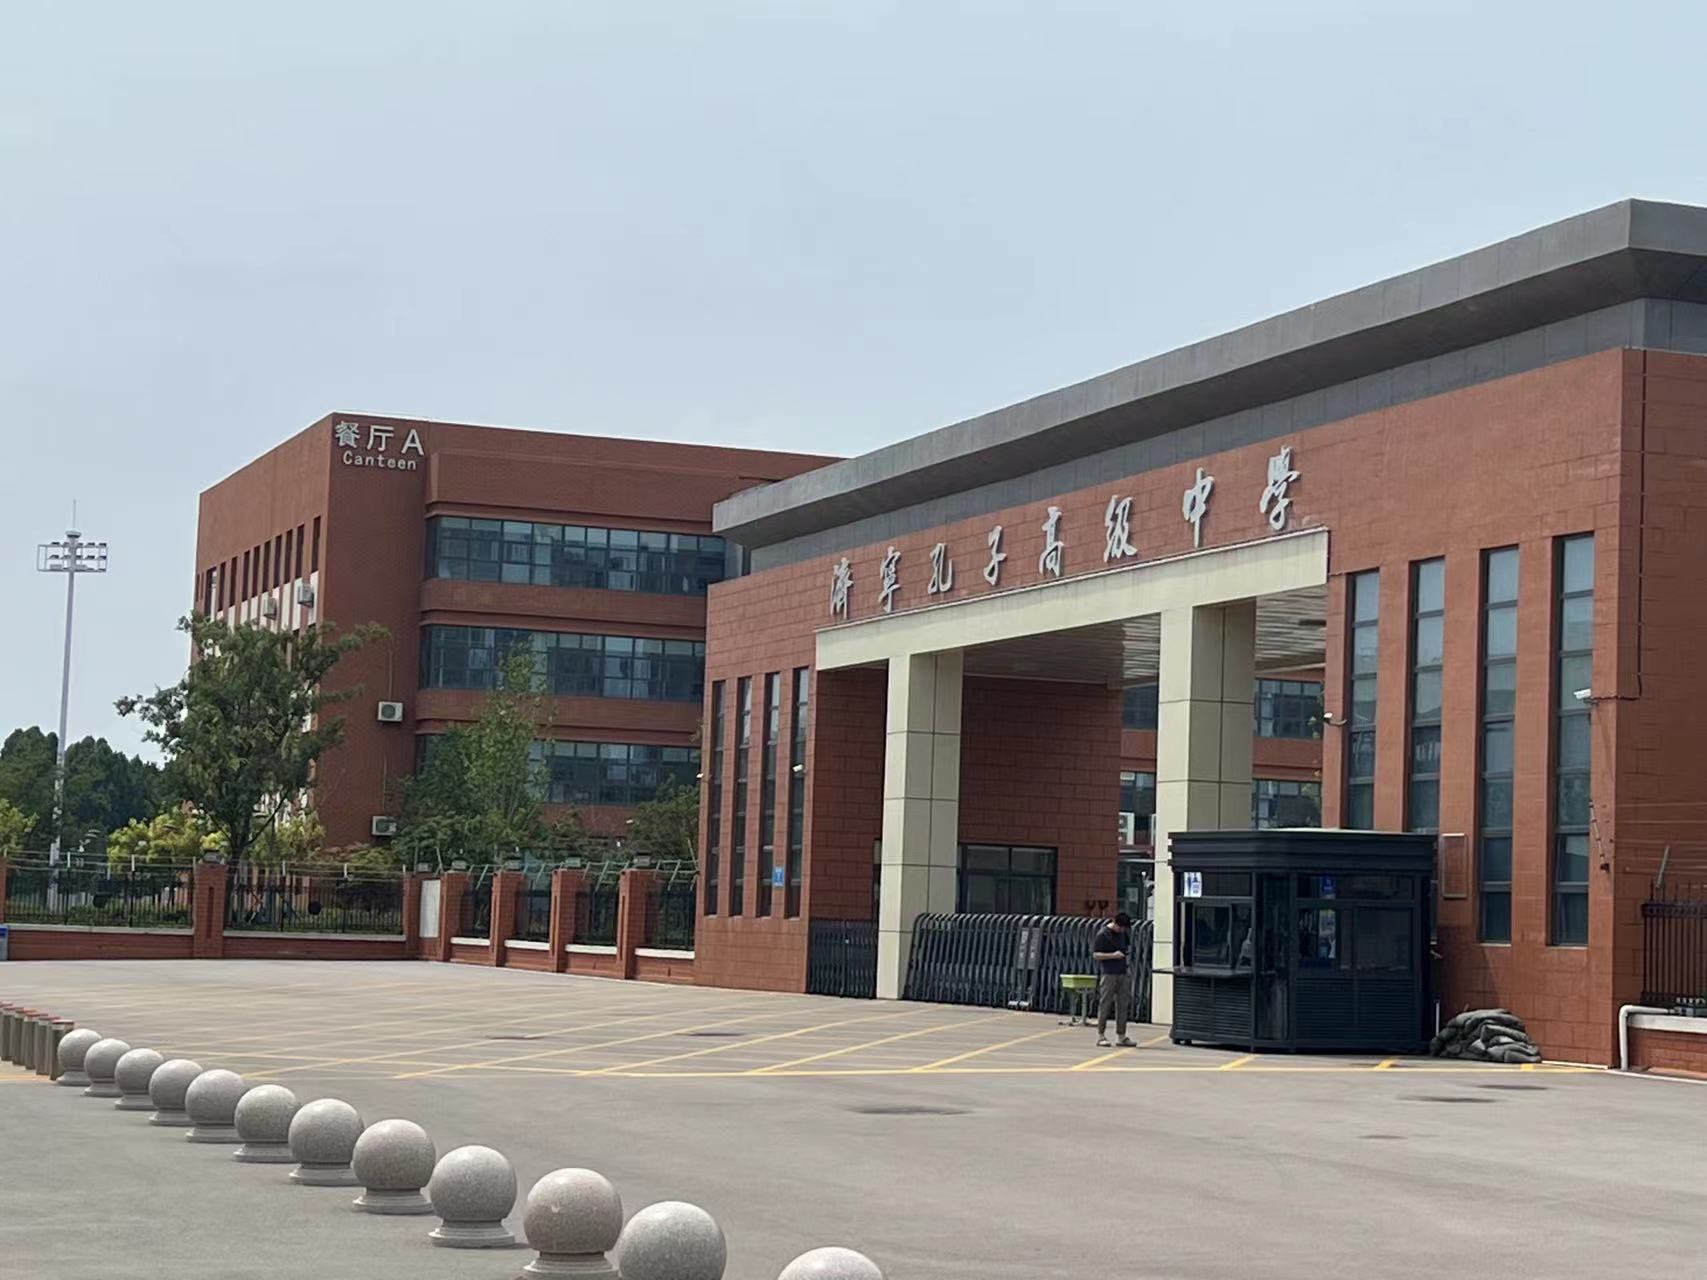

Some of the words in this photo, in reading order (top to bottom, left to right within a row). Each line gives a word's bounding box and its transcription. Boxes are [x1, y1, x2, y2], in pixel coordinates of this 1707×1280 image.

[335, 420, 395, 452] 餐厅
[401, 428, 425, 456] A
[342, 450, 417, 471] Canteen
